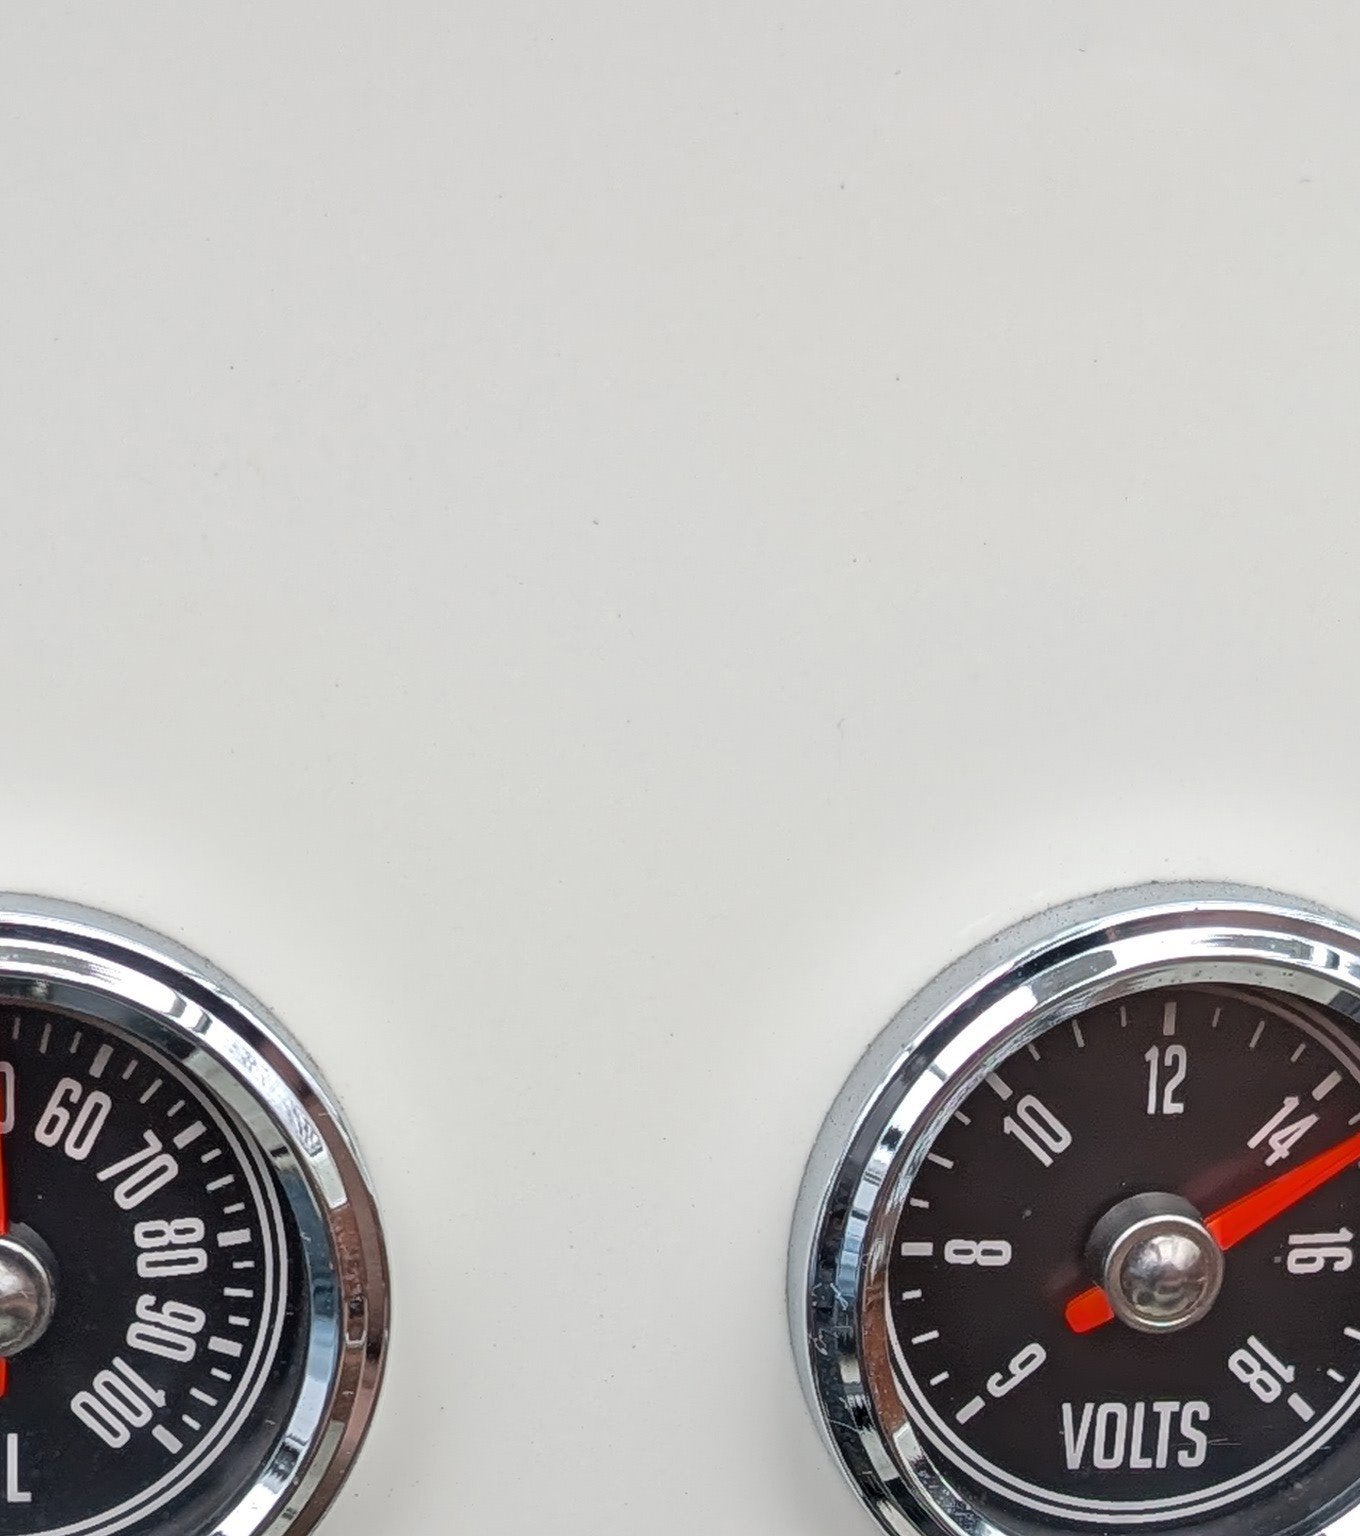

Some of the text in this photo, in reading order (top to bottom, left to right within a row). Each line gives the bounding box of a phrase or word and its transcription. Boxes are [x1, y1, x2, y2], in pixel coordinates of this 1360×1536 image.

[1143, 1044, 1188, 1115] 12
[34, 1076, 112, 1162] 60
[1002, 1093, 1074, 1168] 10
[1245, 1095, 1320, 1168] 14
[96, 1129, 180, 1211] 70
[133, 1217, 208, 1279] 80
[943, 1238, 1013, 1267] 8
[1286, 1227, 1354, 1275] 16
[126, 1293, 207, 1363] 90
[70, 1356, 168, 1449] 100
[985, 1342, 1047, 1399] 6
[1226, 1335, 1296, 1404] 18
[1060, 1400, 1211, 1470] VOLTS
